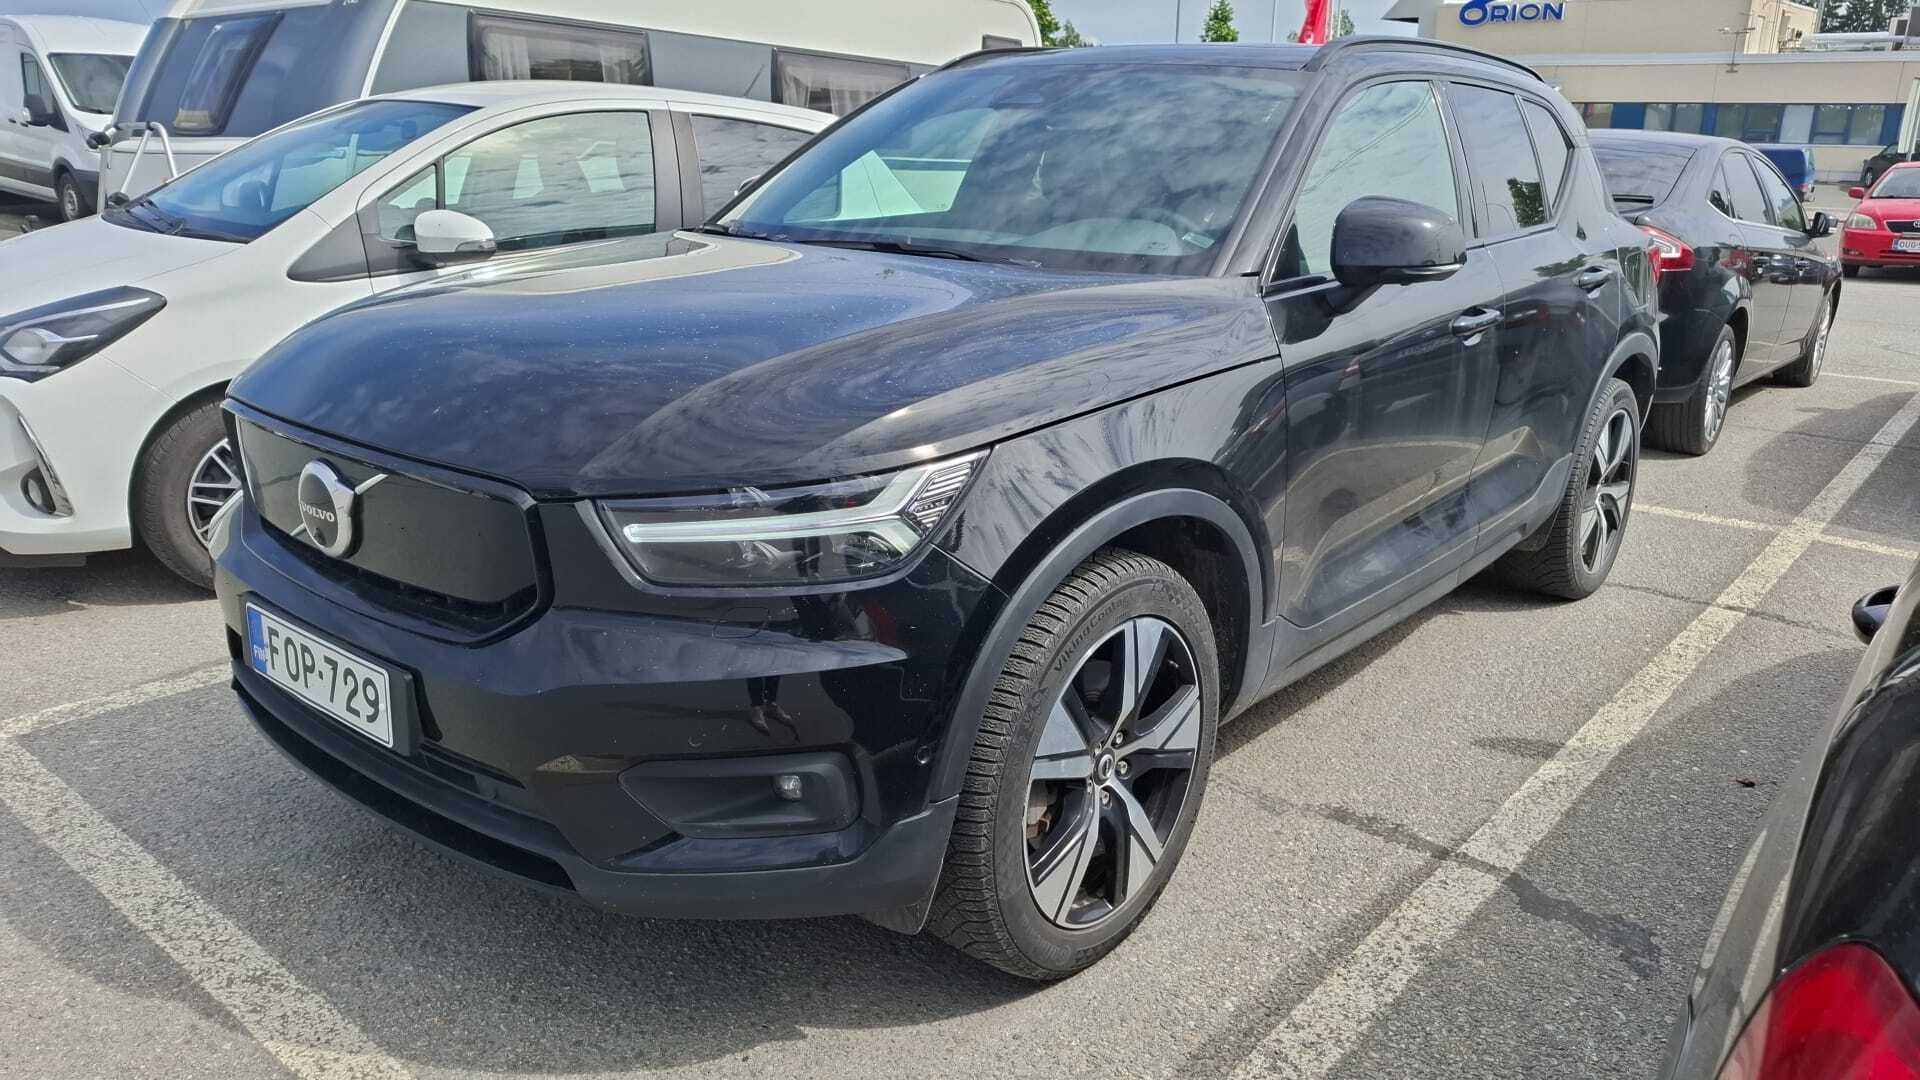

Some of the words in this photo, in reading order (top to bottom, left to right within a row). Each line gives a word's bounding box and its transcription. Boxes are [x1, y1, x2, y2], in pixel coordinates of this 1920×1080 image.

[1459, 0, 1564, 26] ORION
[301, 503, 335, 522] VOLVO
[267, 626, 380, 723] FOP-729
